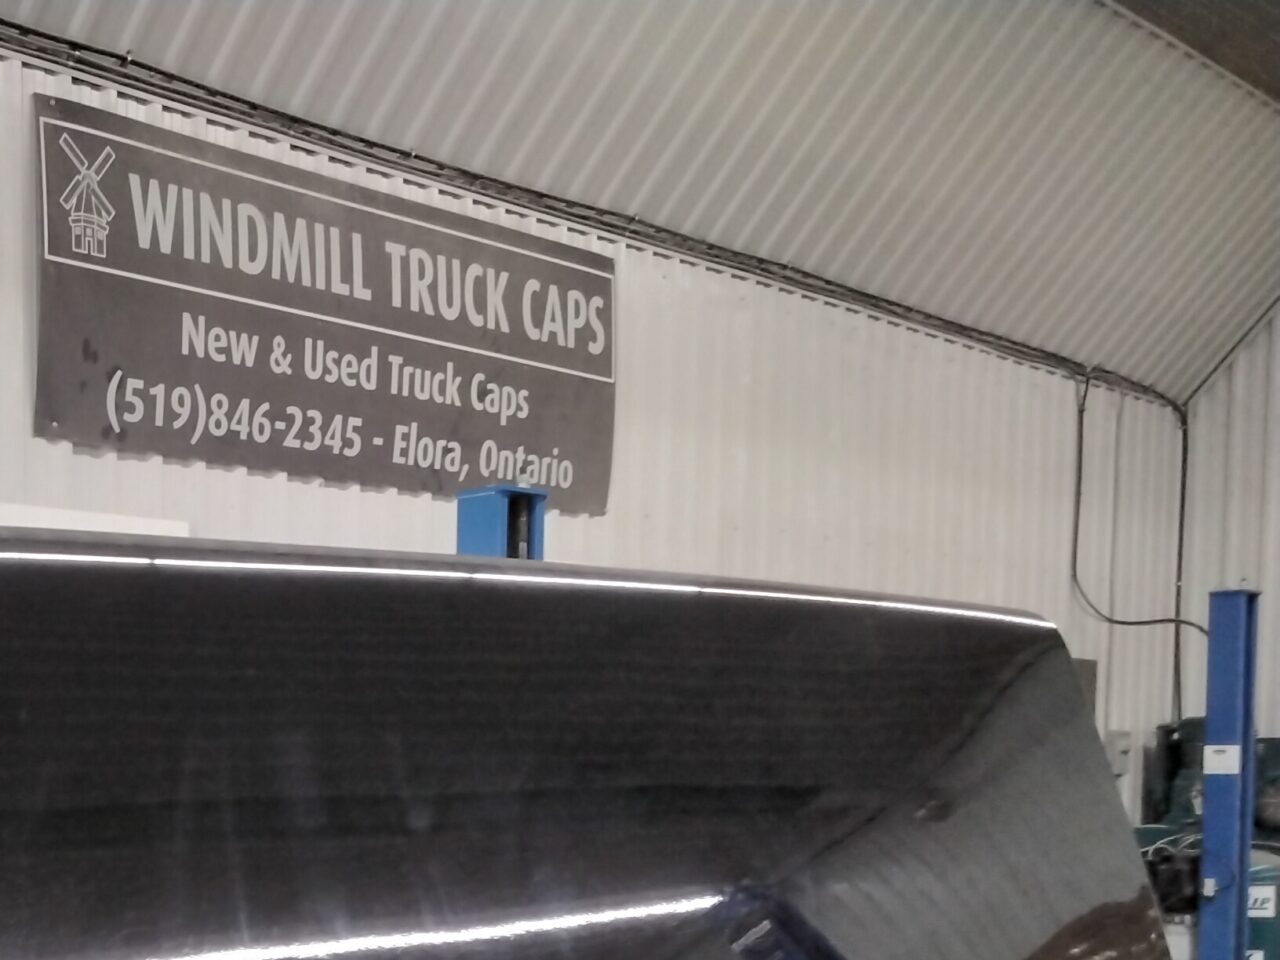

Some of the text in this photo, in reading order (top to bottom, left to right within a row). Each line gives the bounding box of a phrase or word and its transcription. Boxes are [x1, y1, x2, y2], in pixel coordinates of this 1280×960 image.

[128, 173, 605, 355] WINDMILL TRUCK CAPS
[181, 312, 530, 425] New & Used Truck Caps
[106, 369, 362, 458] (519)846-2345
[392, 422, 470, 482] Elora,
[479, 440, 574, 489] Ontario
